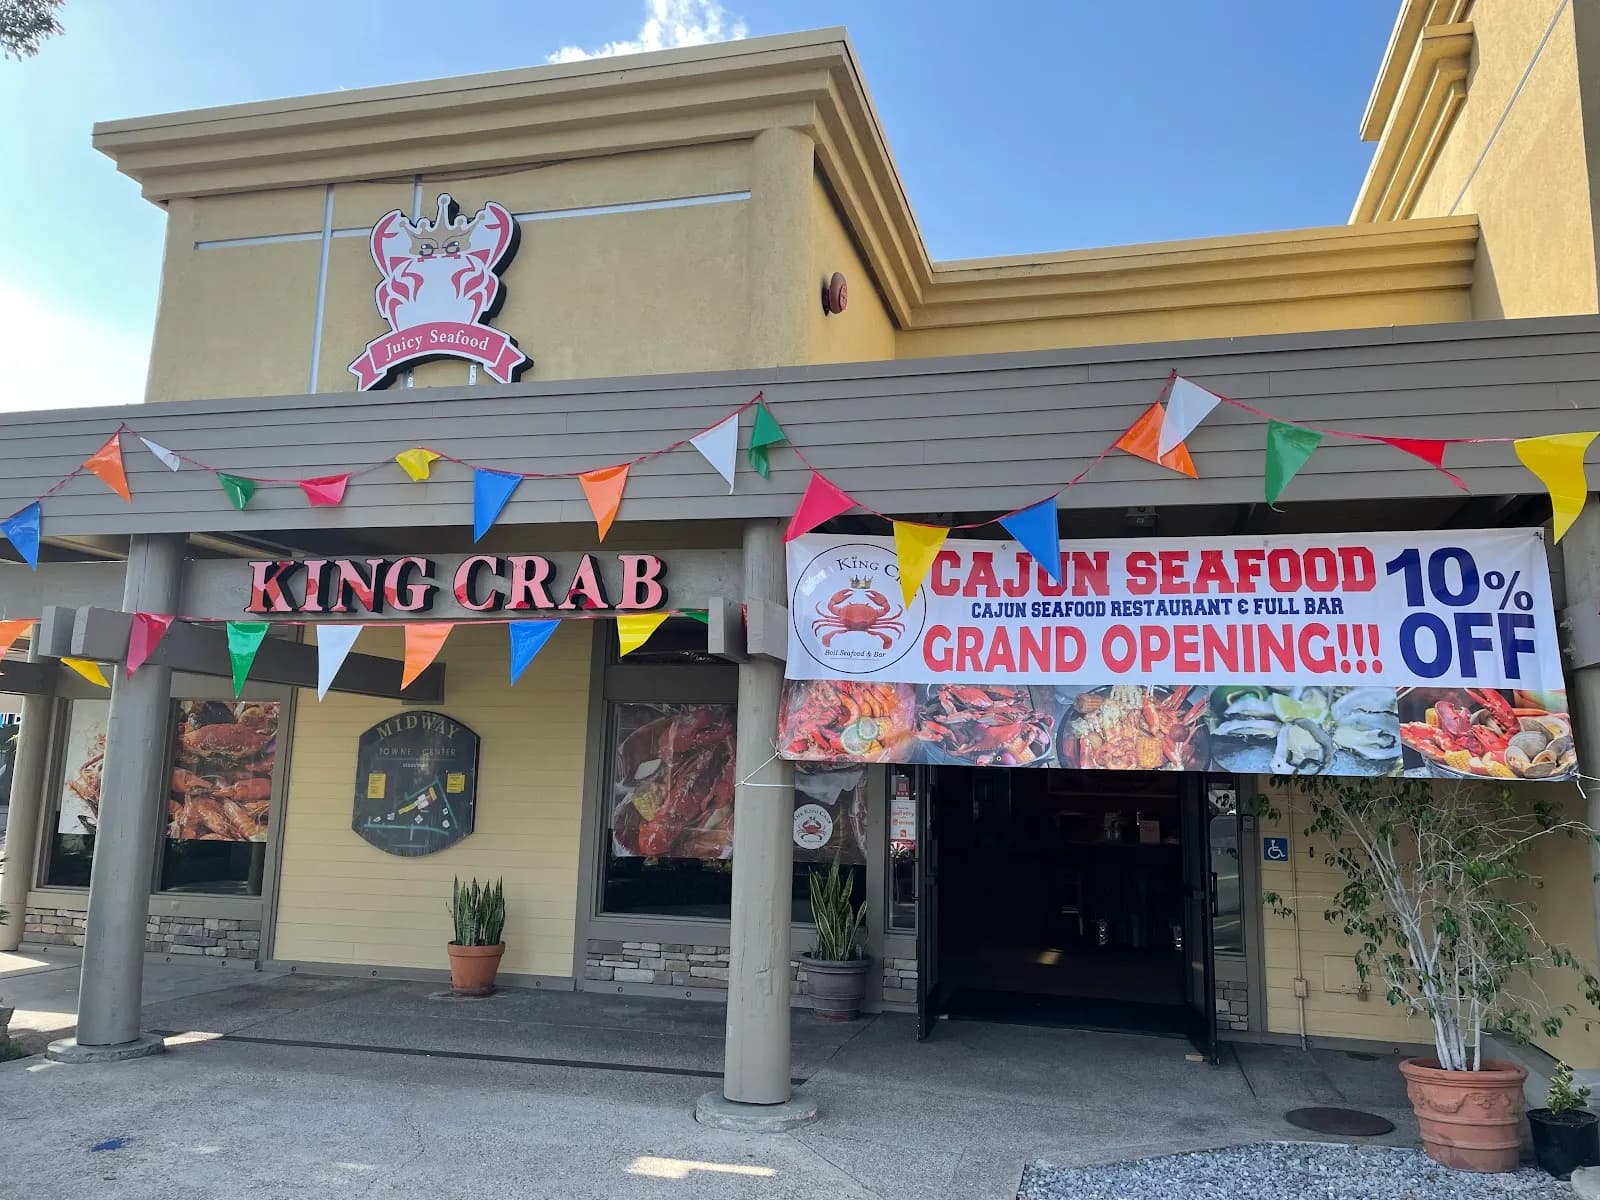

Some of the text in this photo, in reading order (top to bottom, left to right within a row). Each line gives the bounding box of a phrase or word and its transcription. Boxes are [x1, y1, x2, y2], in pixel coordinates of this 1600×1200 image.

[384, 329, 489, 361] Juicy Seafood
[244, 553, 665, 613] KING CRAB
[930, 546, 1377, 597] CAJUN SEAFOOD
[1386, 547, 1534, 611] 10%
[971, 601, 1027, 618] CAJUN
[1031, 600, 1105, 617] SEAFOOD
[1110, 599, 1233, 616] RESTAURANT
[1254, 598, 1300, 615] FULL
[1304, 597, 1344, 615] BAR
[840, 650, 865, 658] Seafood
[922, 622, 1384, 674] GRAND OPENING!!!
[1399, 612, 1536, 680] OFF
[376, 715, 460, 741] MIDWAY
